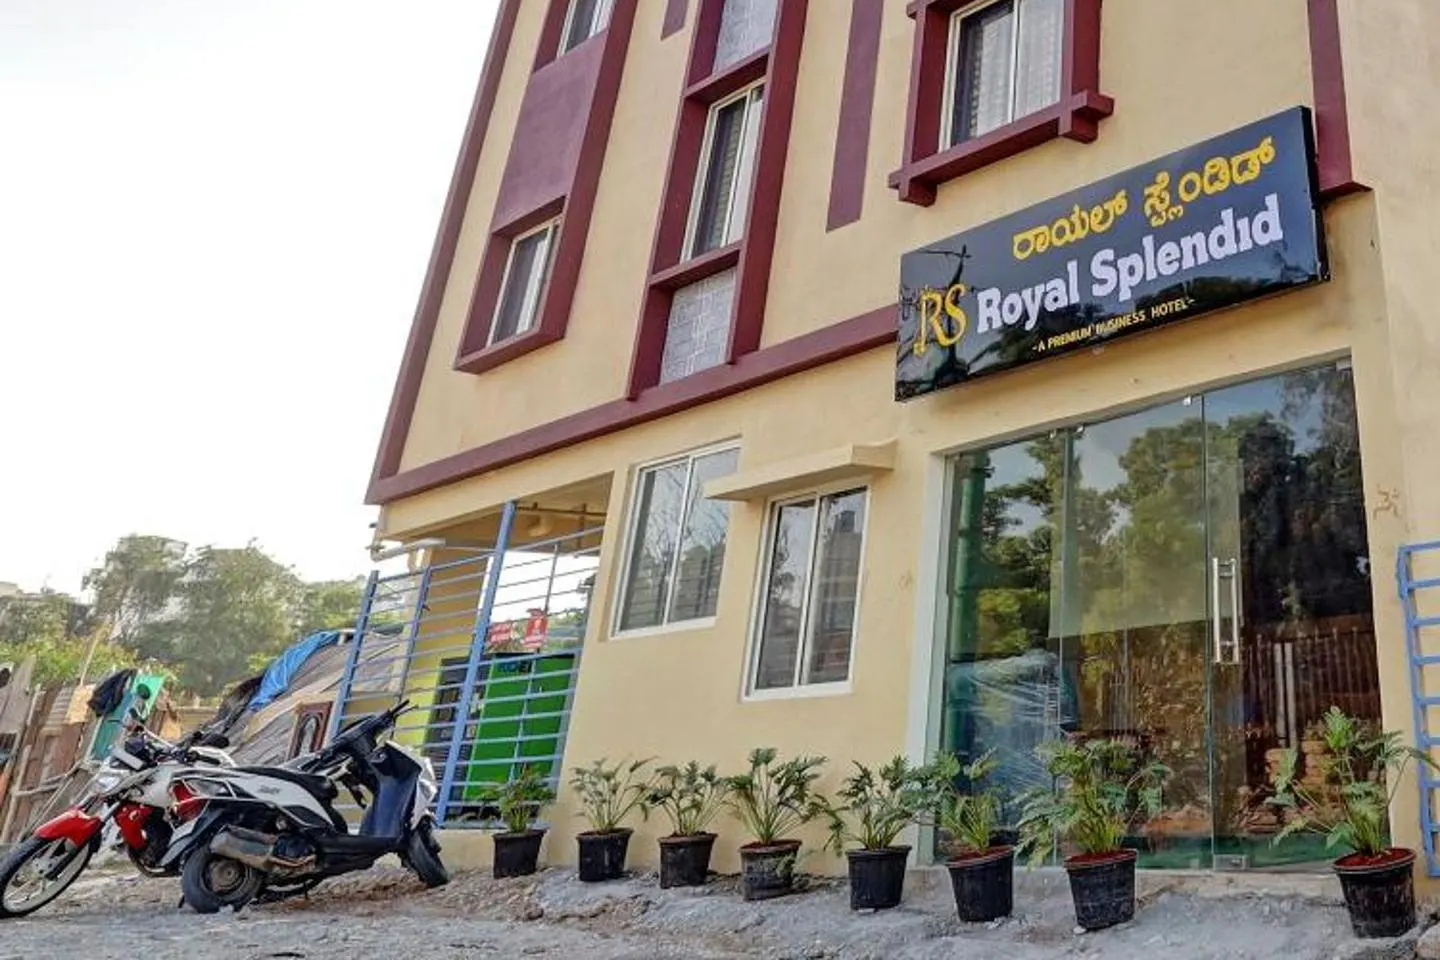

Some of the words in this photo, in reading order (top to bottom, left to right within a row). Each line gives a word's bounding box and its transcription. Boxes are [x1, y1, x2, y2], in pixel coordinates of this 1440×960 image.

[1013, 189, 1128, 260] ರಾಯಲ್
[977, 260, 1080, 333] Royal
[1090, 193, 1283, 301] Splendid
[913, 283, 967, 356] RS
[1048, 324, 1093, 349] PREMIUM
[1095, 310, 1146, 335] BUSINESS
